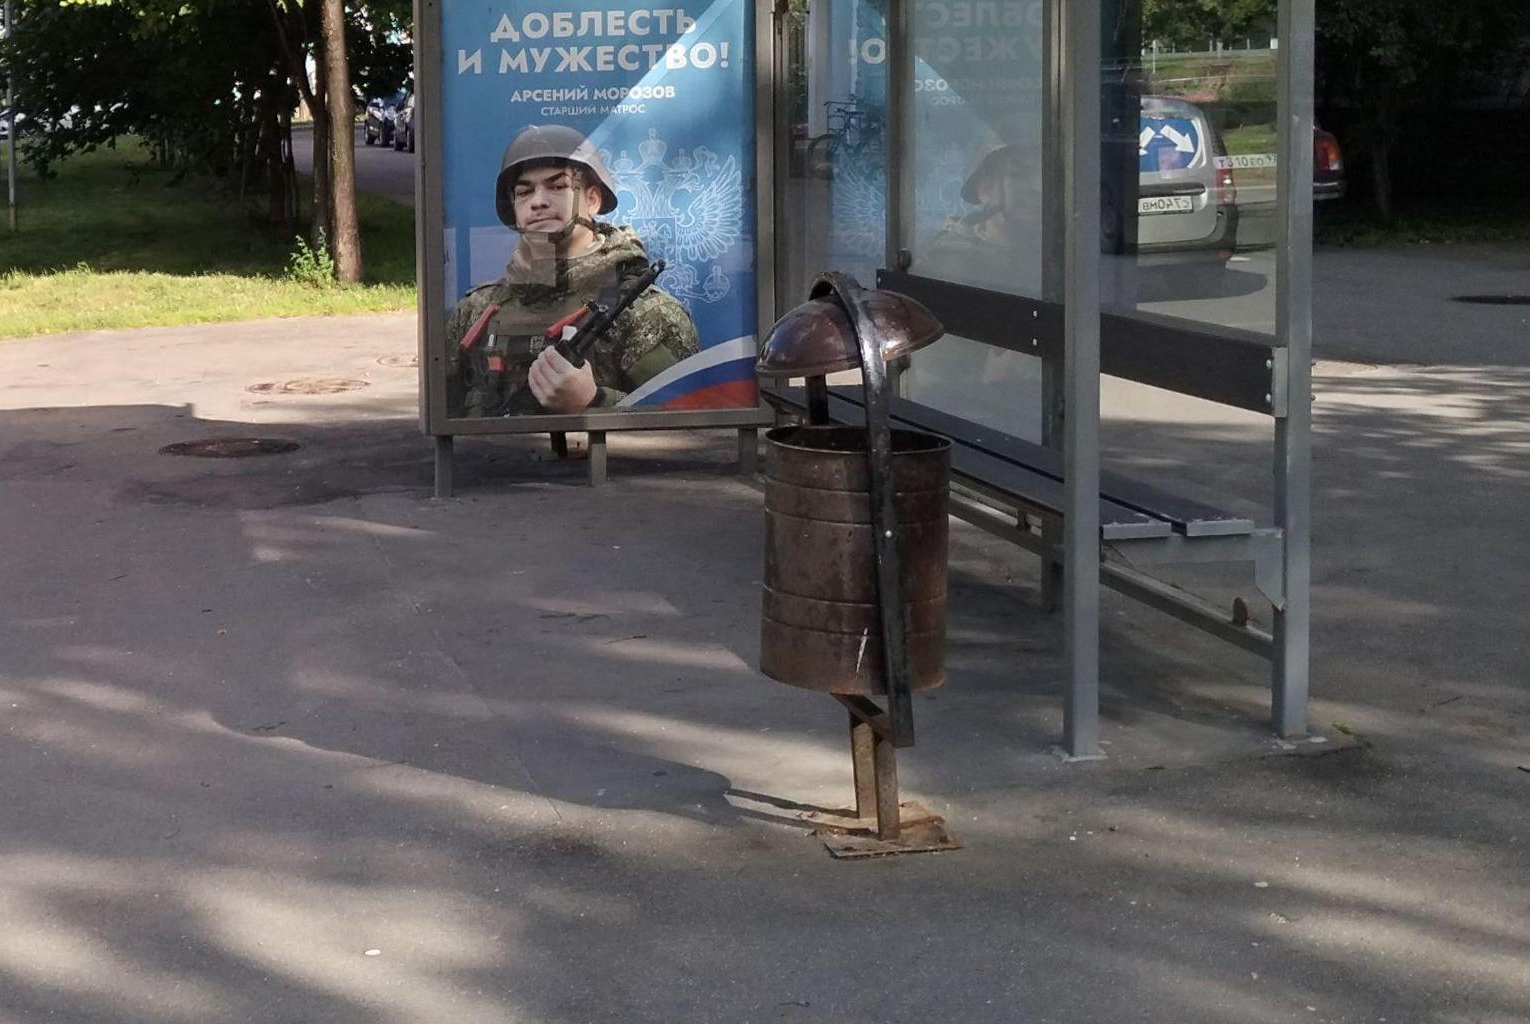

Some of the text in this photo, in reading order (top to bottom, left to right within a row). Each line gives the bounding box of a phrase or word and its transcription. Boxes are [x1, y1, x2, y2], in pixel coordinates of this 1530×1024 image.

[490, 8, 697, 43] ДОБЛЕСТЬ
[458, 41, 730, 74] И МУЖЕСТВО!
[510, 84, 676, 103] АРСЕНИЙ МОРОЗОВ
[600, 104, 646, 114] МАТРОС
